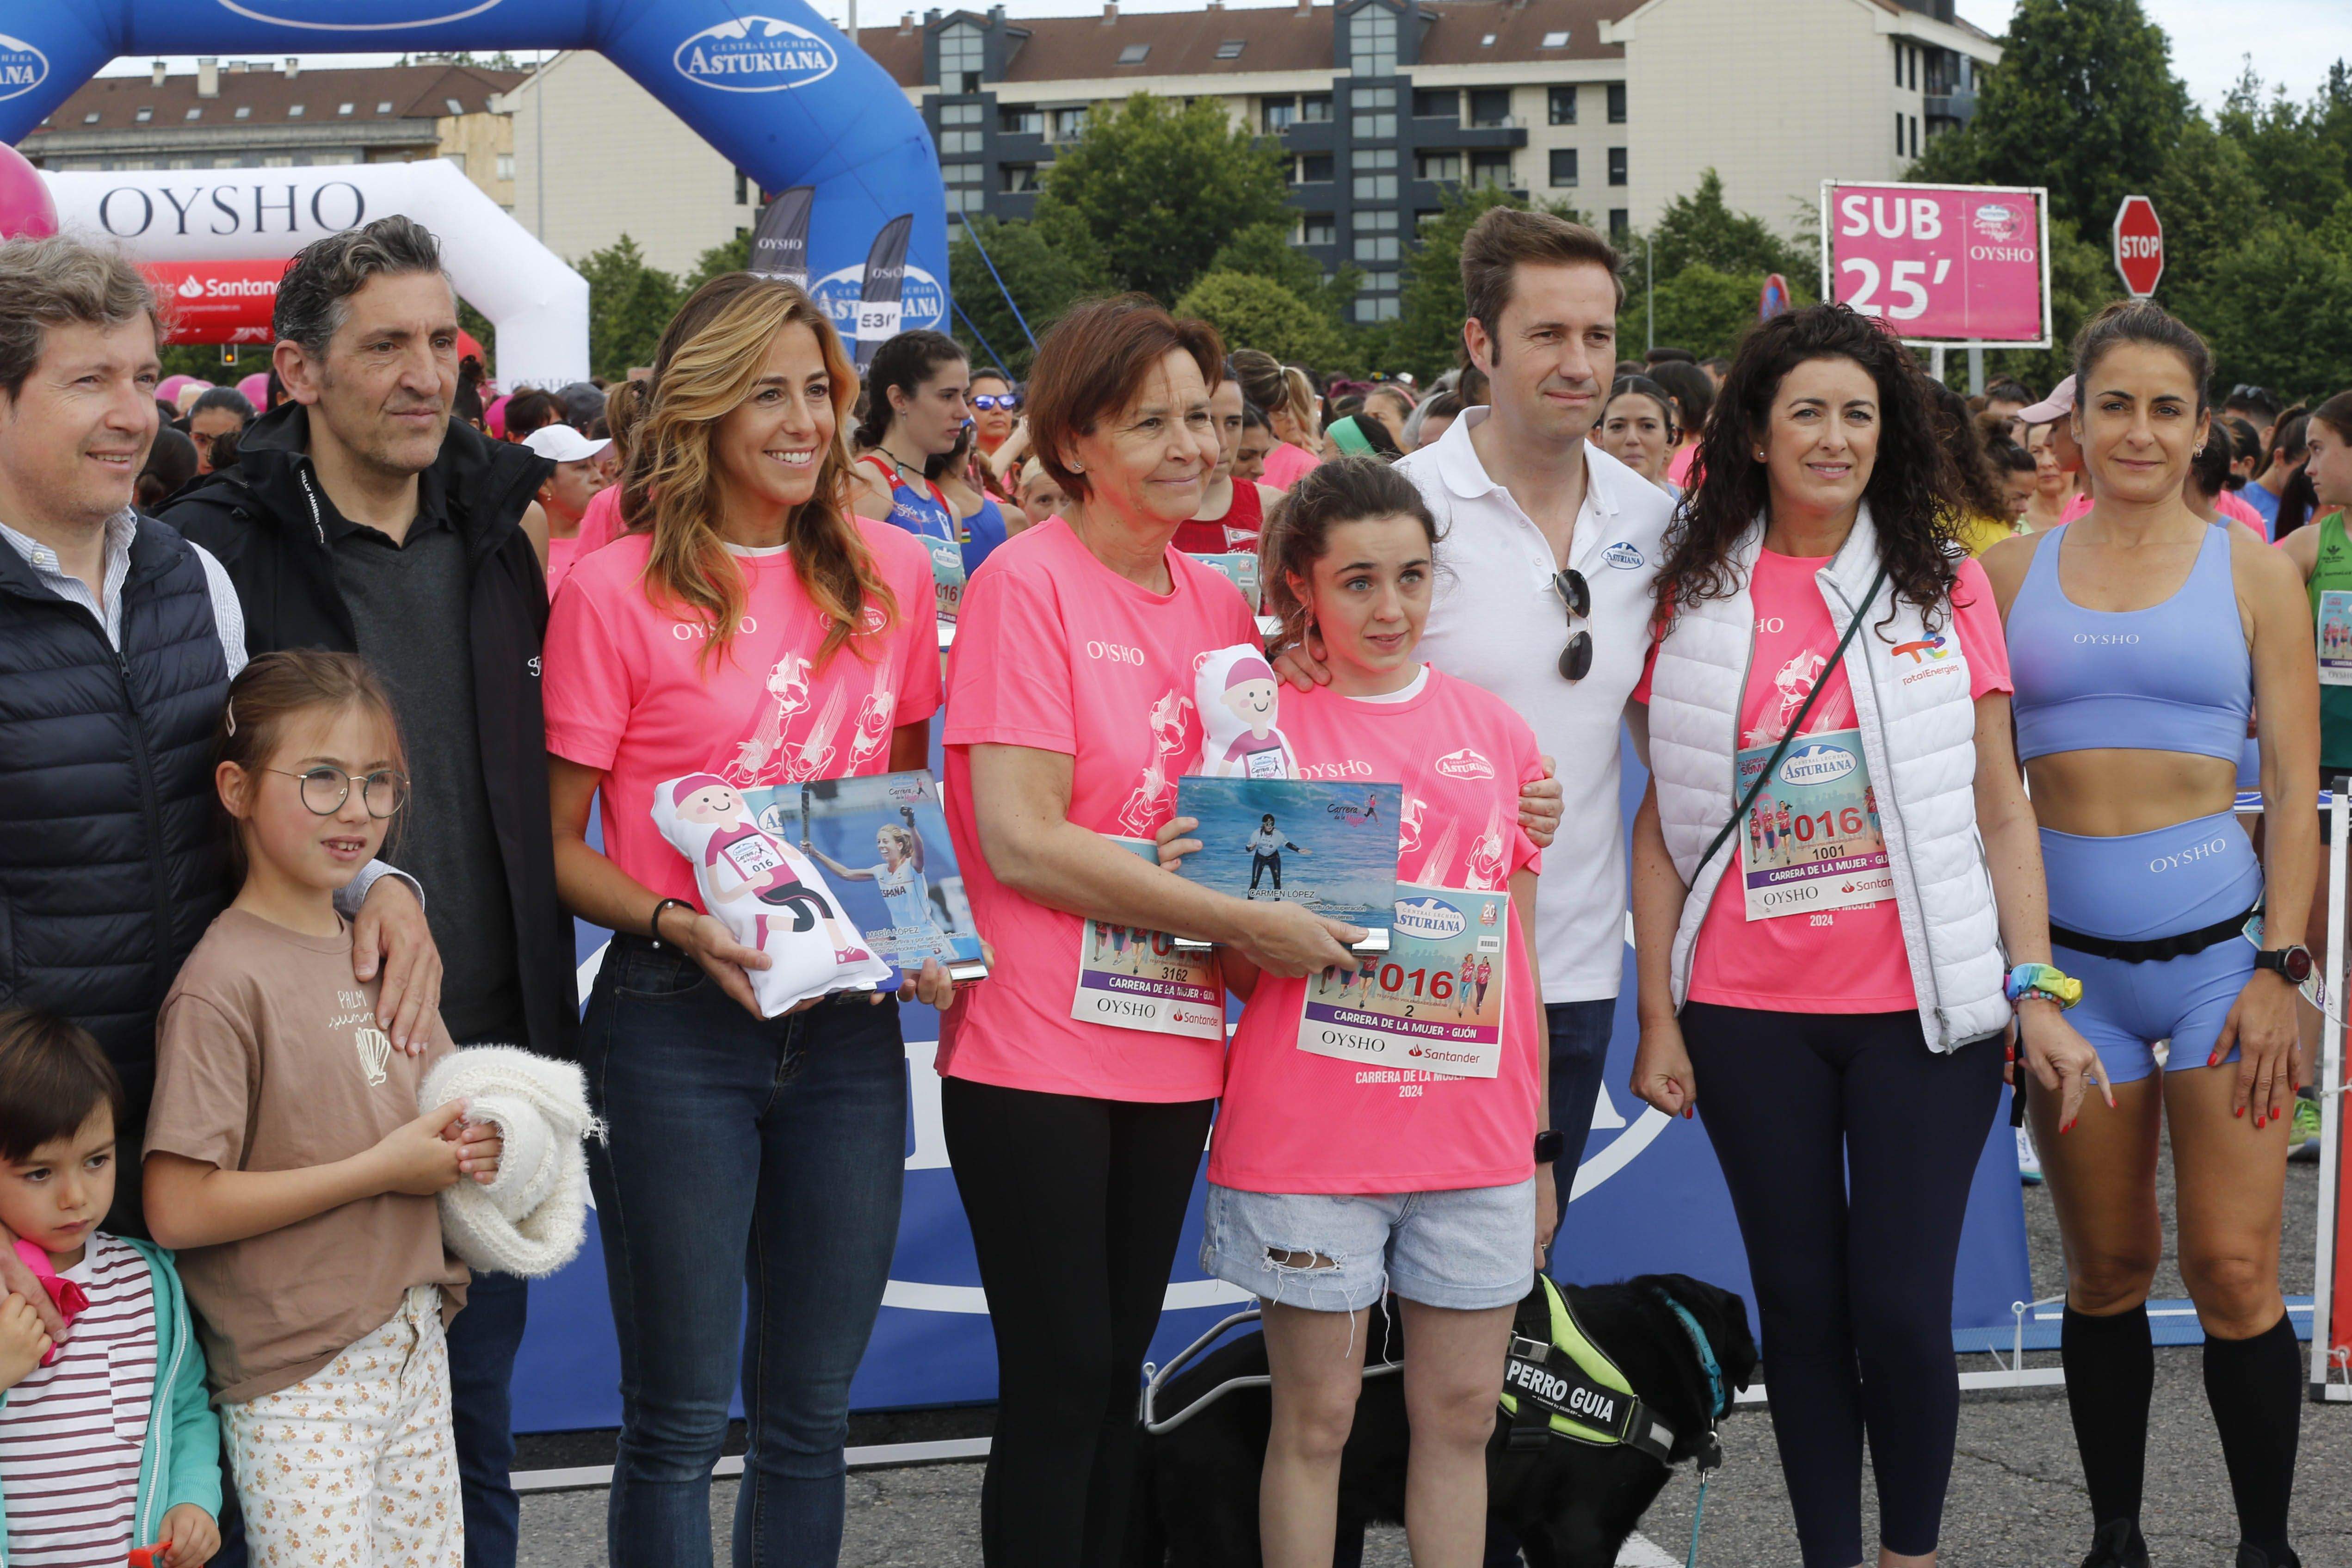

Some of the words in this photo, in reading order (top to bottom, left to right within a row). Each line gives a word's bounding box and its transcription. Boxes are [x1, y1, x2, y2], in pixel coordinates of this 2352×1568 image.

[711, 42, 765, 52] CENTRAL
[688, 46, 828, 74] ASTURIANA
[99, 181, 366, 237] OYSHO
[1840, 195, 1943, 241] SUB
[758, 237, 802, 250] OYSHO
[2121, 235, 2160, 259] STOP
[1970, 245, 2034, 263] OYSHO
[206, 278, 281, 297] Santan
[301, 469, 311, 492] HELLY
[309, 493, 320, 524] HANSEN
[1607, 552, 1641, 564] ASTURIANA
[935, 583, 957, 601] 016
[673, 617, 757, 640] OYO
[2074, 634, 2139, 644] OYSHO
[1087, 641, 1144, 666] OYSHO
[1902, 664, 1959, 685] TotalEnergies
[1443, 761, 1493, 775] ASTURIANA
[1784, 760, 1852, 779] ASTURIANA
[1327, 804, 1358, 814] Carrera
[1794, 807, 1863, 841] 016
[1813, 845, 1845, 860] 1001
[2150, 838, 2226, 873] OYSHO
[752, 859, 773, 872] 016
[1769, 868, 1805, 882] CARRERA
[1808, 865, 1820, 875] DE
[1822, 862, 1833, 872] LA
[1836, 858, 1867, 870] MUJER
[1875, 854, 1887, 864] GIJ
[1249, 889, 1285, 898] CARMEN
[1288, 889, 1315, 898] LÓPEZ
[1764, 886, 1818, 906] OYSHO
[1857, 878, 1894, 891] Santan
[1403, 907, 1432, 918] CENTRAL
[1433, 911, 1460, 920] LECHERA
[1483, 904, 1495, 918] 20
[1810, 914, 1833, 926] 2024
[866, 927, 895, 939] MARÍA
[895, 926, 920, 936] LÓPEZ
[884, 938, 910, 947] deportiva
[1162, 967, 1188, 982] 3162
[1379, 963, 1453, 1000] 016
[1109, 977, 1151, 992] CARRERA
[1153, 983, 1163, 994] DE
[1164, 984, 1175, 995] LA
[1177, 986, 1199, 999] MUJER
[338, 990, 366, 1008] PALM
[1097, 998, 1156, 1019] OYSHO
[1184, 1012, 1218, 1026] Santander
[1405, 1005, 1414, 1018] 2
[1334, 1010, 1378, 1027] CARRERA
[1381, 1018, 1394, 1029] DE
[1396, 1020, 1408, 1031] LA
[1411, 1023, 1444, 1037] MUJER
[1452, 1025, 1477, 1039] GIJÓN
[1321, 1030, 1385, 1053] OYSHO
[1424, 1049, 1480, 1064] Santander
[1356, 1071, 1400, 1084] CARRERA
[1403, 1070, 1416, 1082] DE
[1419, 1070, 1431, 1082] LA
[1399, 1085, 1423, 1098] 2024
[1506, 1360, 1568, 1401] PERRO
[1570, 1388, 1614, 1422] GUIA
[1537, 1396, 1553, 1407] Licensed
